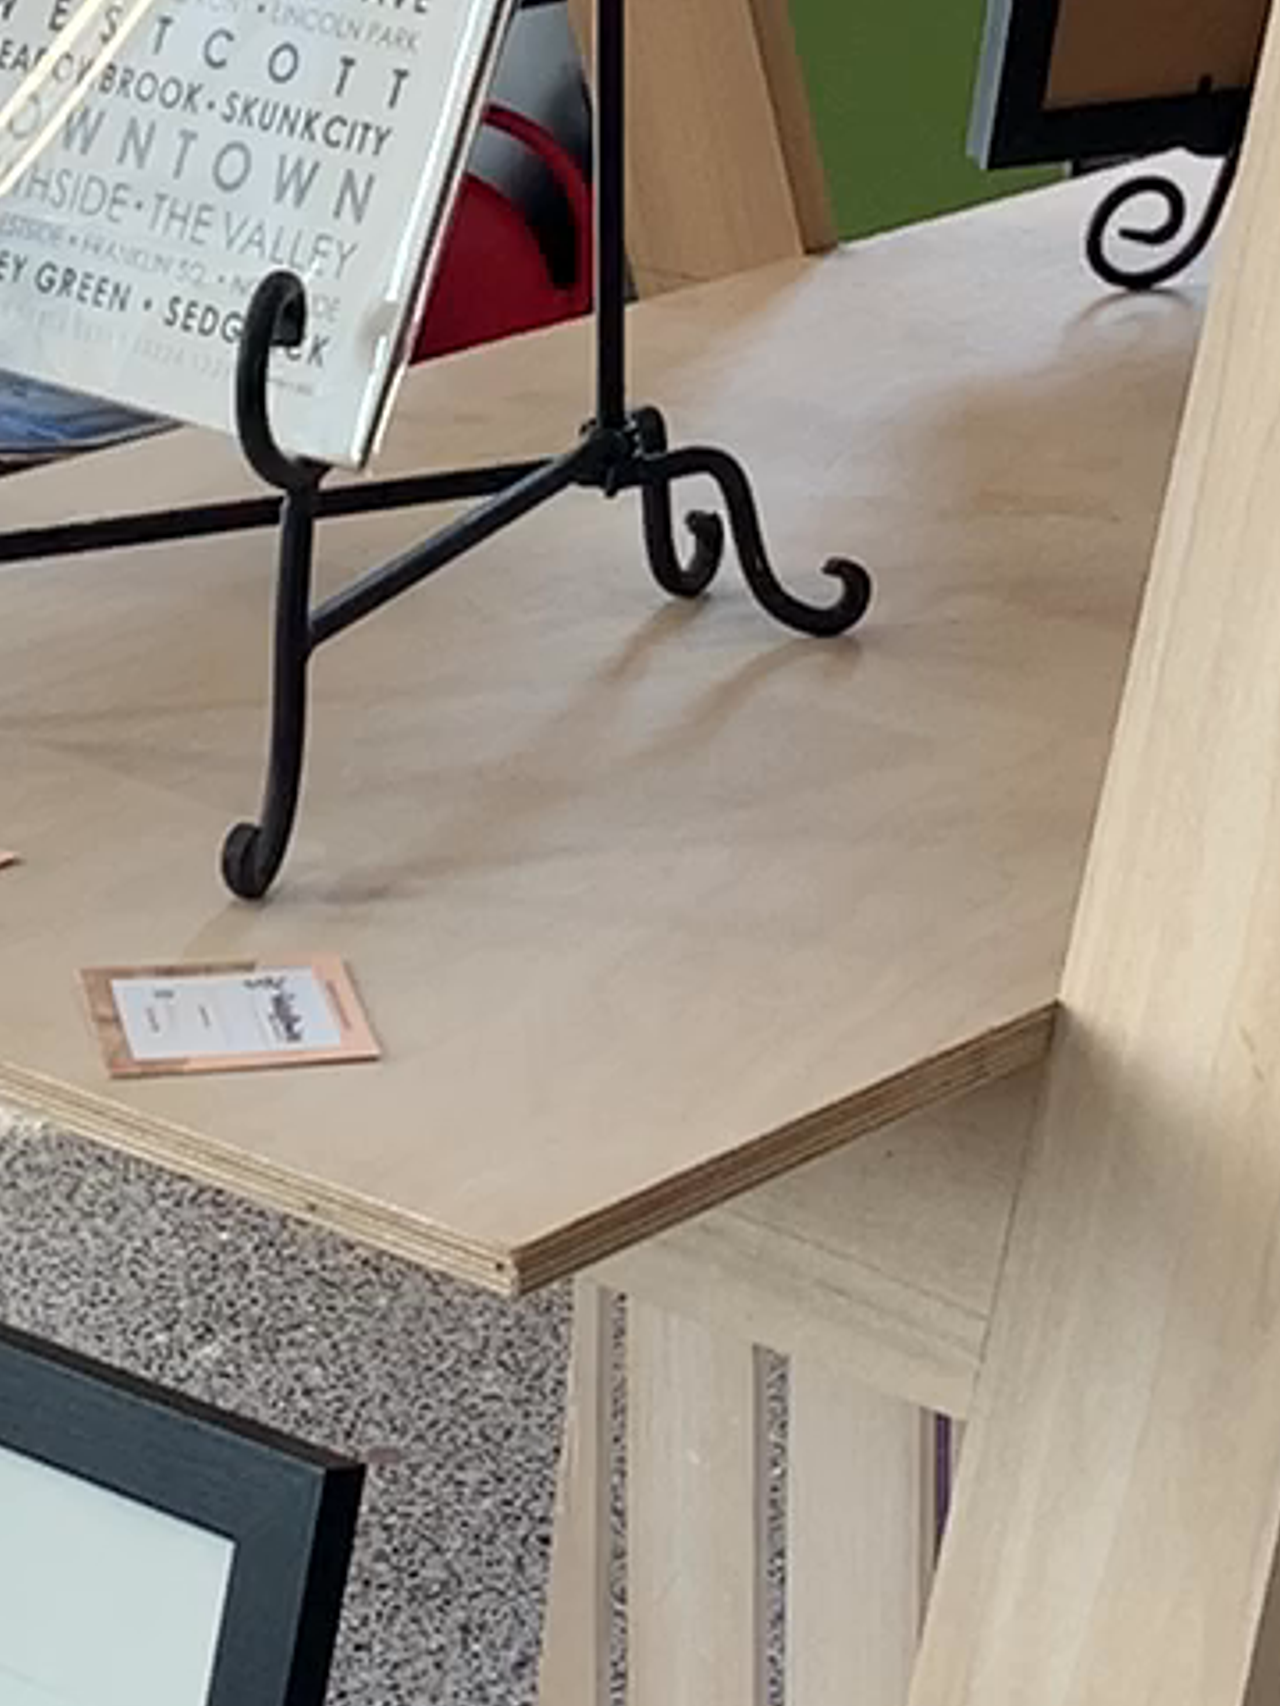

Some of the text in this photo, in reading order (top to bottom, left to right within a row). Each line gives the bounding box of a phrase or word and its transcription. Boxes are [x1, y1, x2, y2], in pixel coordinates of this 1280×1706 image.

[221, 89, 319, 142] SKUNK
[323, 117, 392, 159] CITY
[153, 191, 221, 246] THE
[218, 209, 359, 281] VALLEY
[35, 260, 132, 311] GREEN
